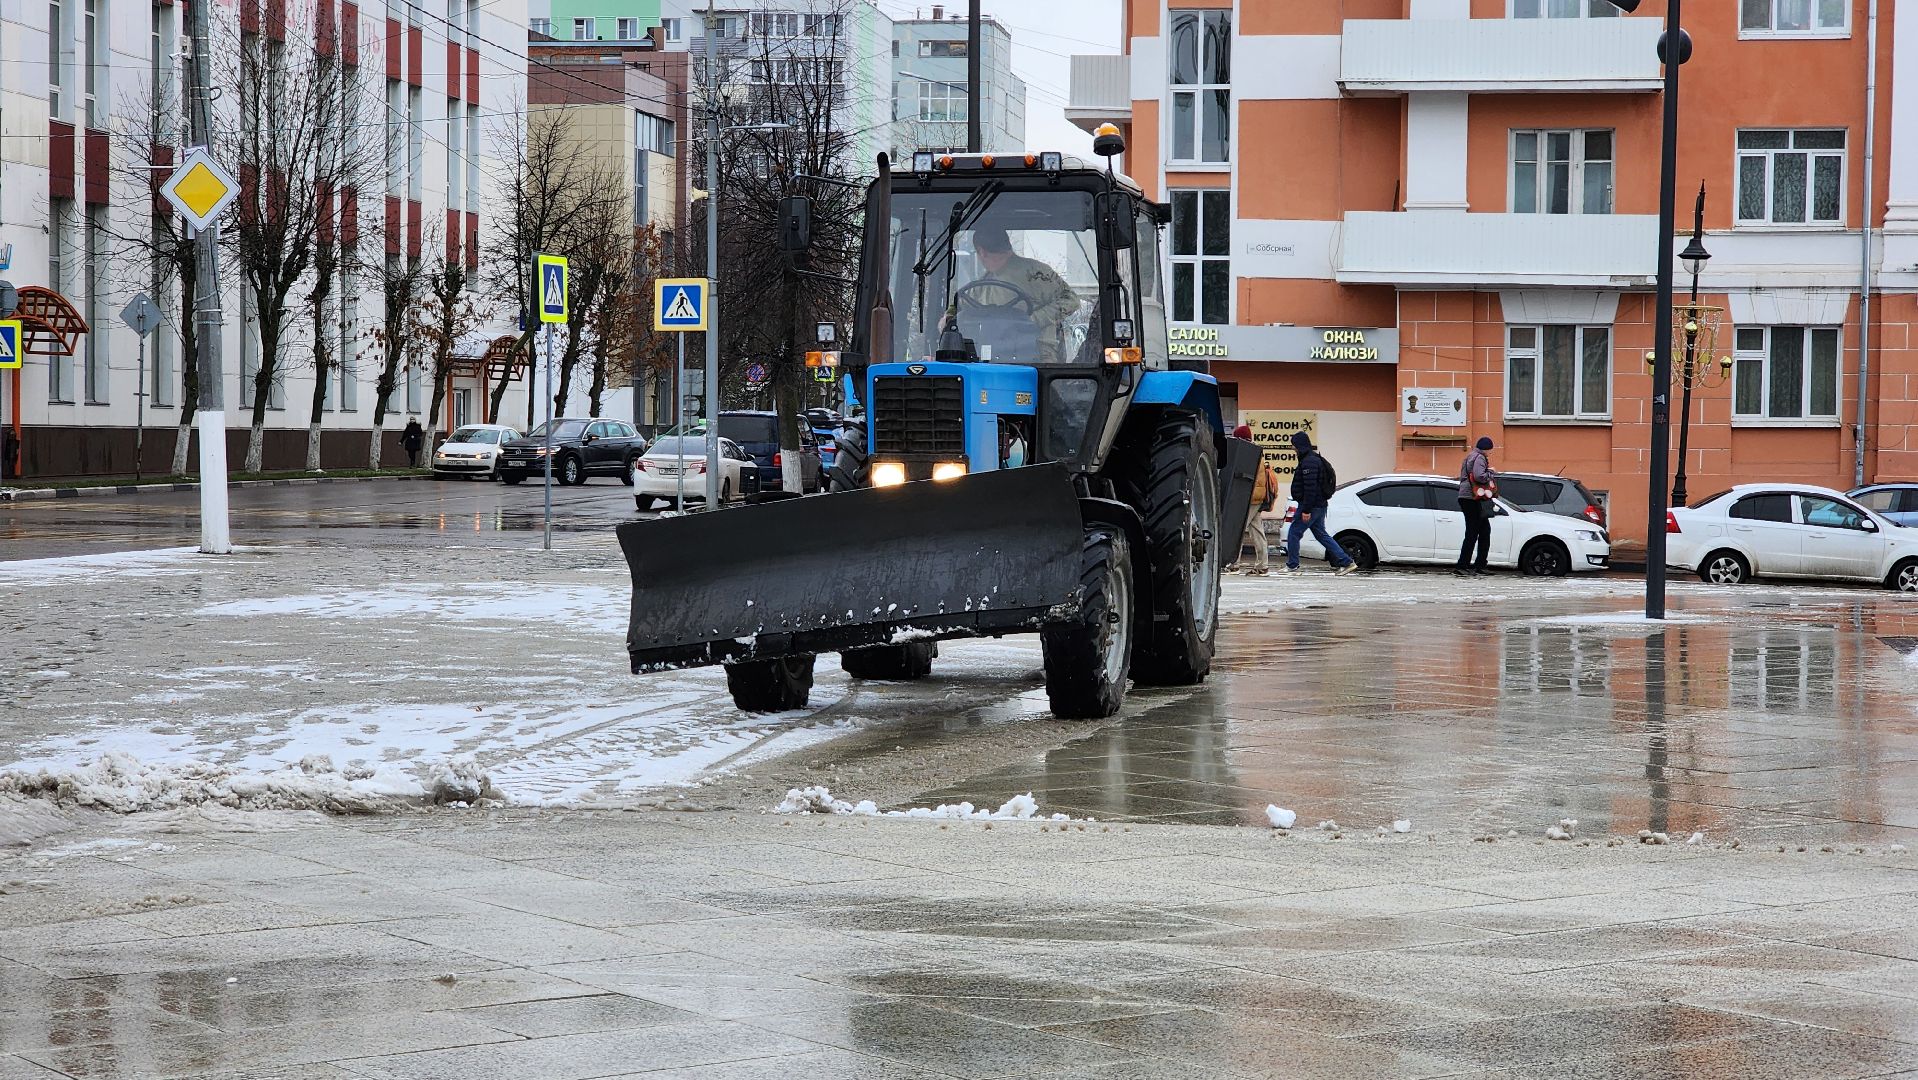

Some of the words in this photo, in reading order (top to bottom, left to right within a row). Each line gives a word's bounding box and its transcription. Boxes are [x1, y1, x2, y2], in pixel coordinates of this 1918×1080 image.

[1168, 327, 1219, 341] САЛОН
[1323, 330, 1365, 344] ОКНА
[1168, 343, 1229, 357] РАСОТЫ
[1310, 346, 1379, 360] ЖАЛЮЗИ
[1261, 421, 1299, 430] САЛОН
[1263, 453, 1296, 461] ЕМОН
